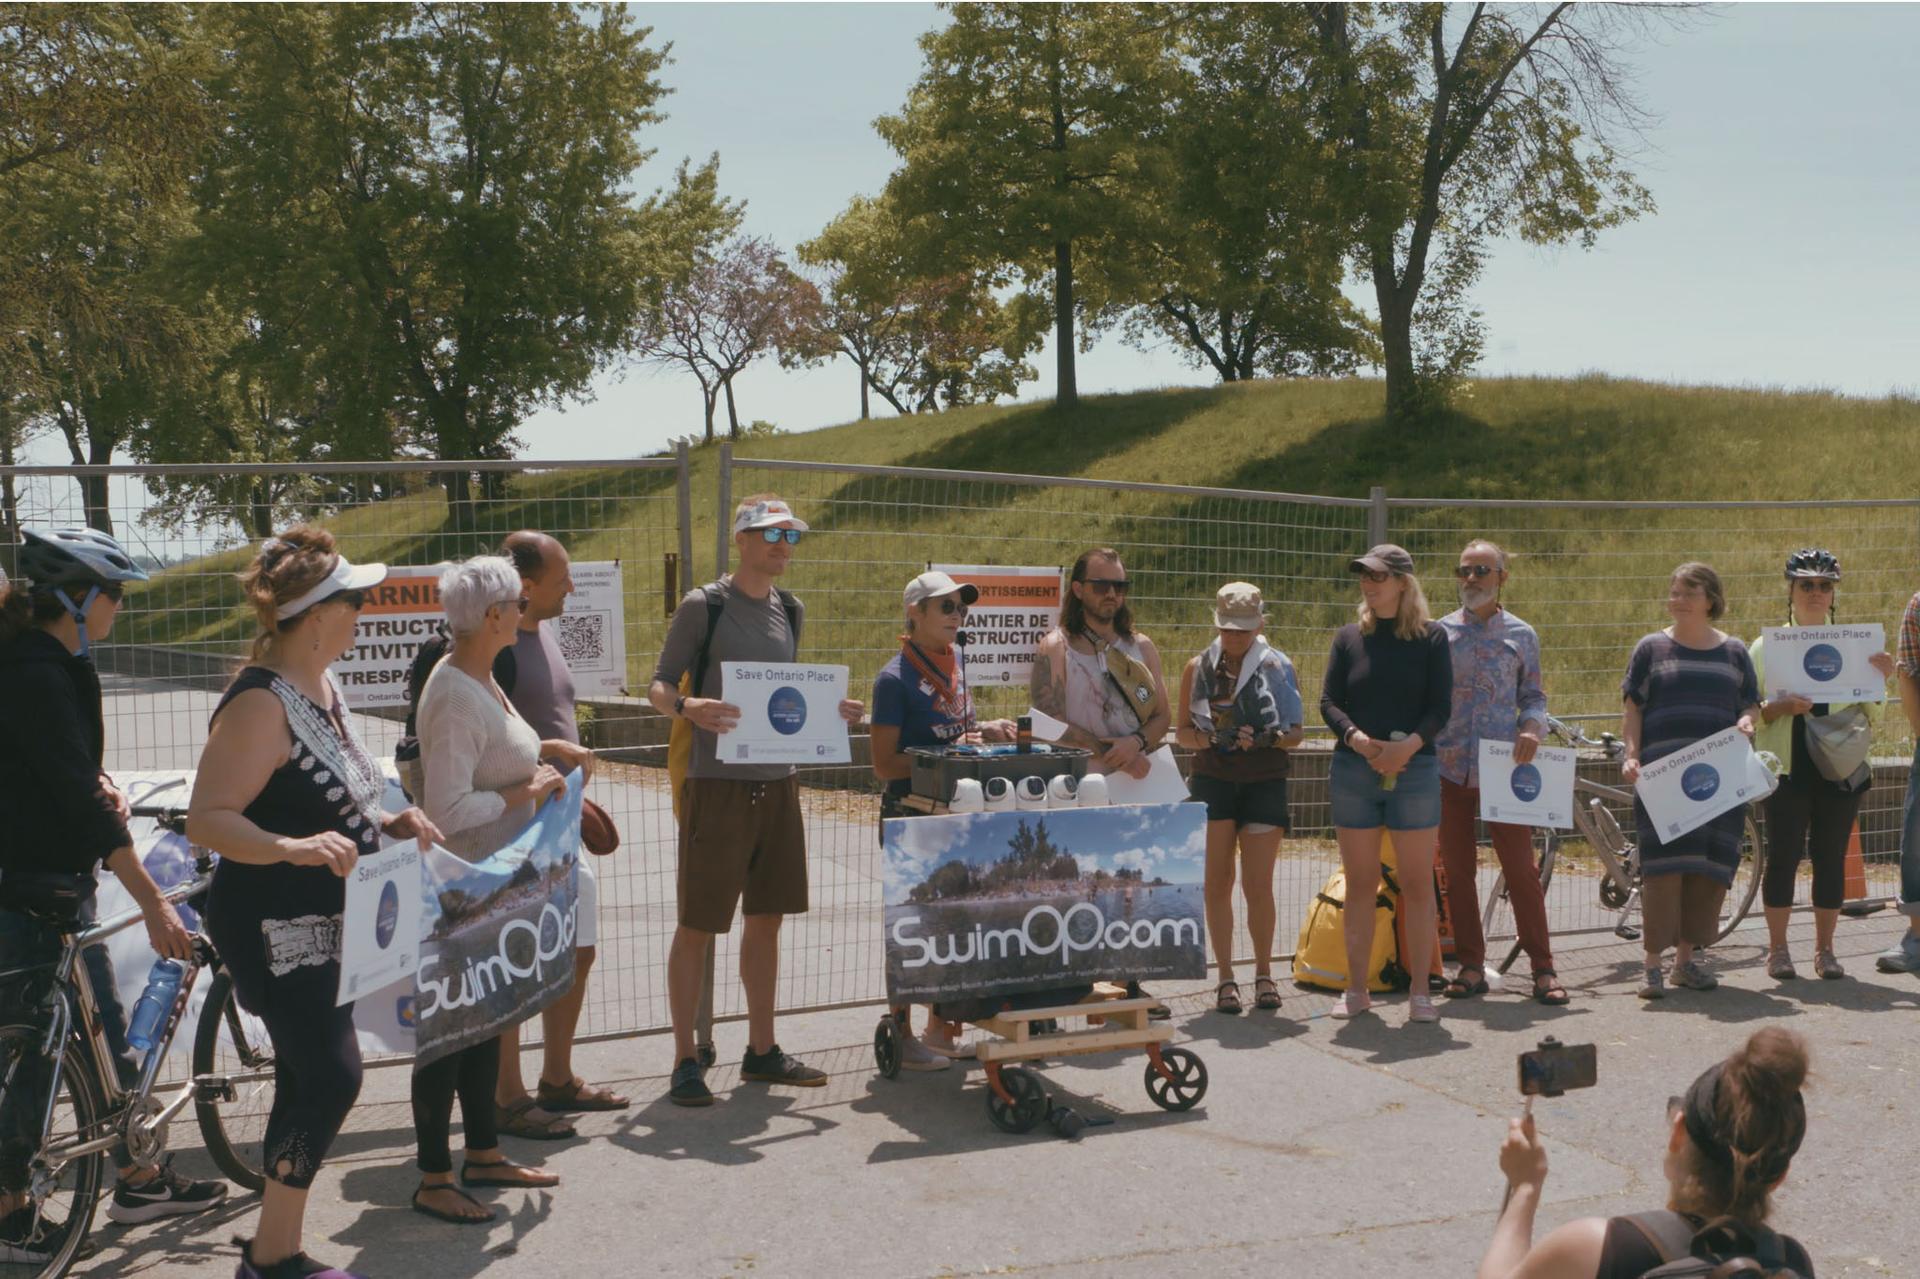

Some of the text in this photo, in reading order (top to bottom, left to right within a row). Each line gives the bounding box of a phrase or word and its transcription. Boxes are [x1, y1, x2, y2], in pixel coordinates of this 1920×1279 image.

[960, 613, 1049, 628] ANTIER DE
[965, 631, 1050, 645] STRUCTIO
[1774, 629, 1872, 641] Save Ontario Place
[334, 643, 424, 661] CTIVIT
[735, 668, 836, 682] Save Ontario Place
[367, 691, 401, 702] Ontario
[1543, 751, 1567, 762] Place
[1643, 734, 1735, 781] Save Ontario Place
[358, 866, 378, 883] Save
